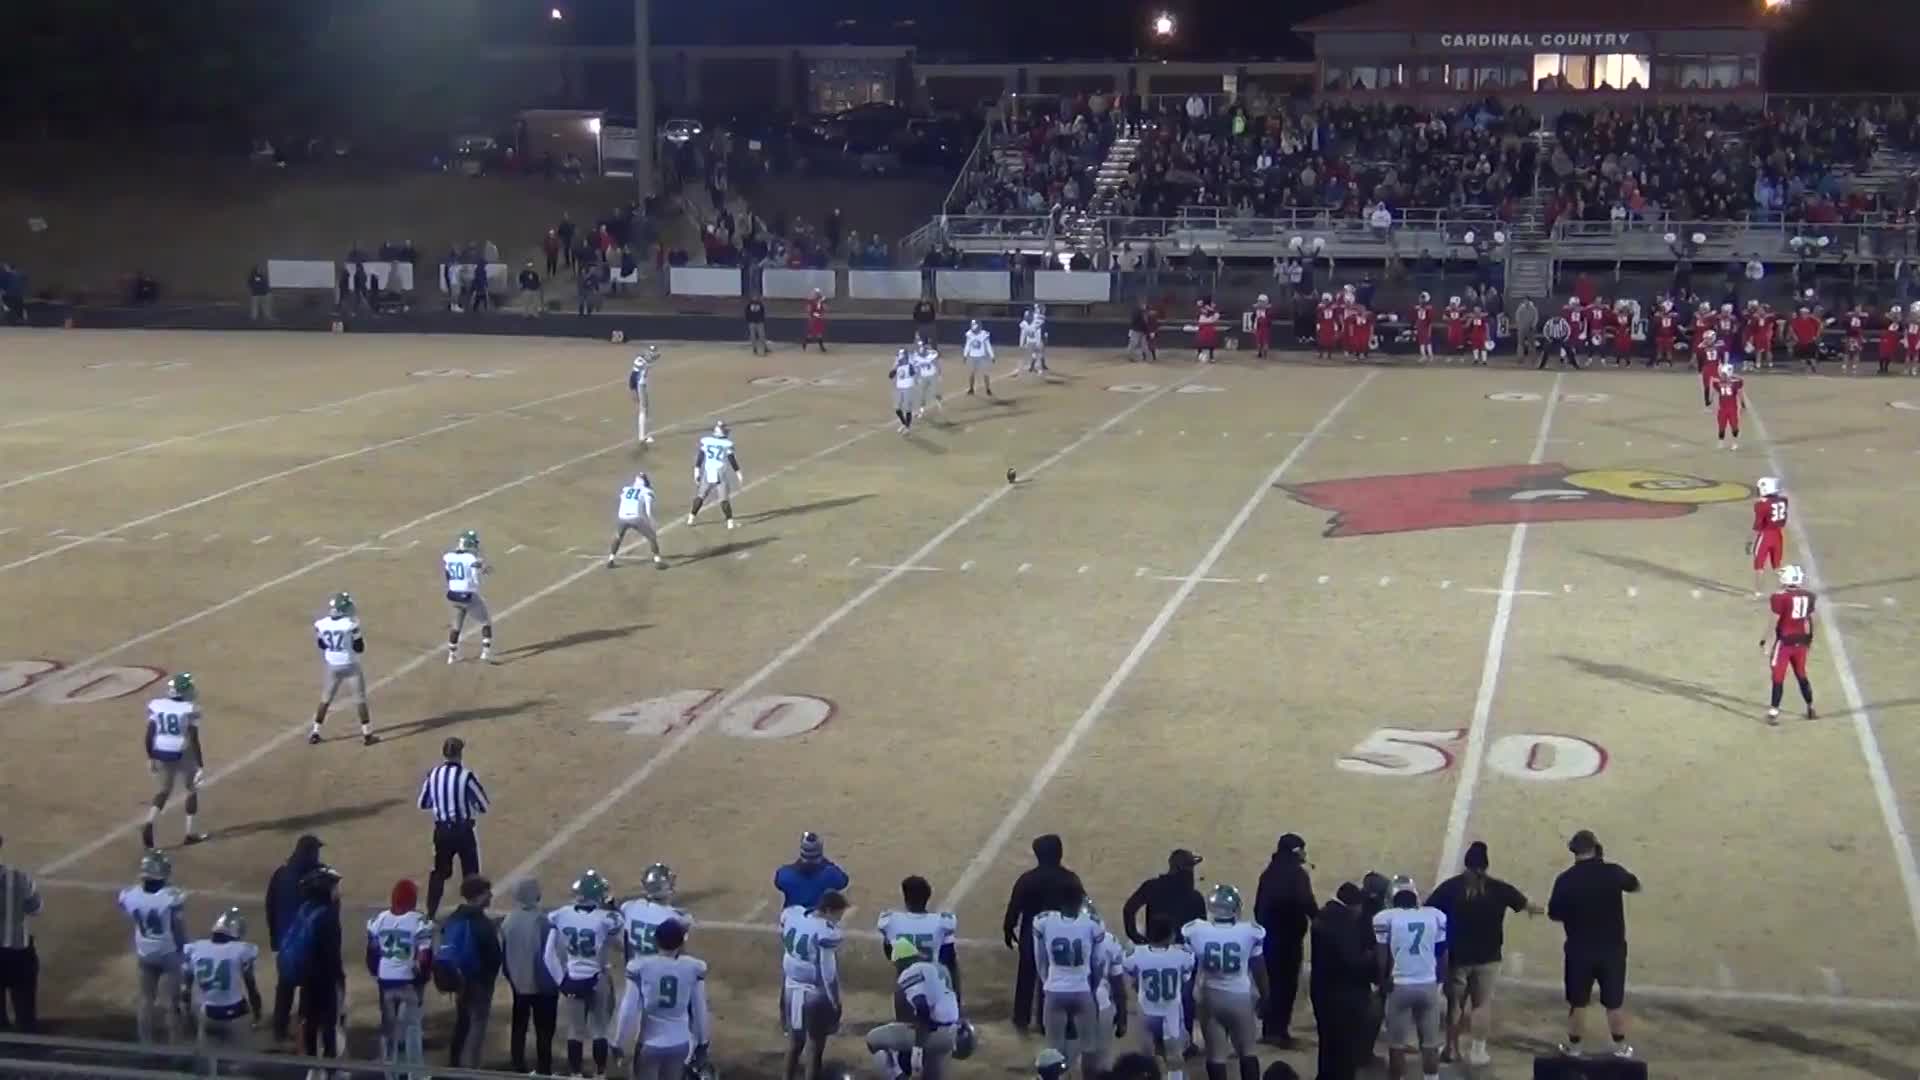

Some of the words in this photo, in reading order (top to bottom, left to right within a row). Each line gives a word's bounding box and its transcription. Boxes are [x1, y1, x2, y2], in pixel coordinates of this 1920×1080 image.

[1441, 34, 1533, 46] CARDINAL
[1541, 33, 1630, 46] COUNTRY
[1771, 502, 1785, 522] 32
[447, 562, 465, 581] 50
[157, 711, 181, 736] 18
[588, 687, 838, 740] 40
[1335, 726, 1608, 780] 50
[563, 926, 597, 957] 32
[1051, 936, 1083, 967] 21
[1407, 922, 1426, 955] 7
[1203, 941, 1241, 973] 66
[196, 957, 231, 992] 24
[1142, 967, 1178, 1003] 30
[659, 976, 679, 1008] 9
